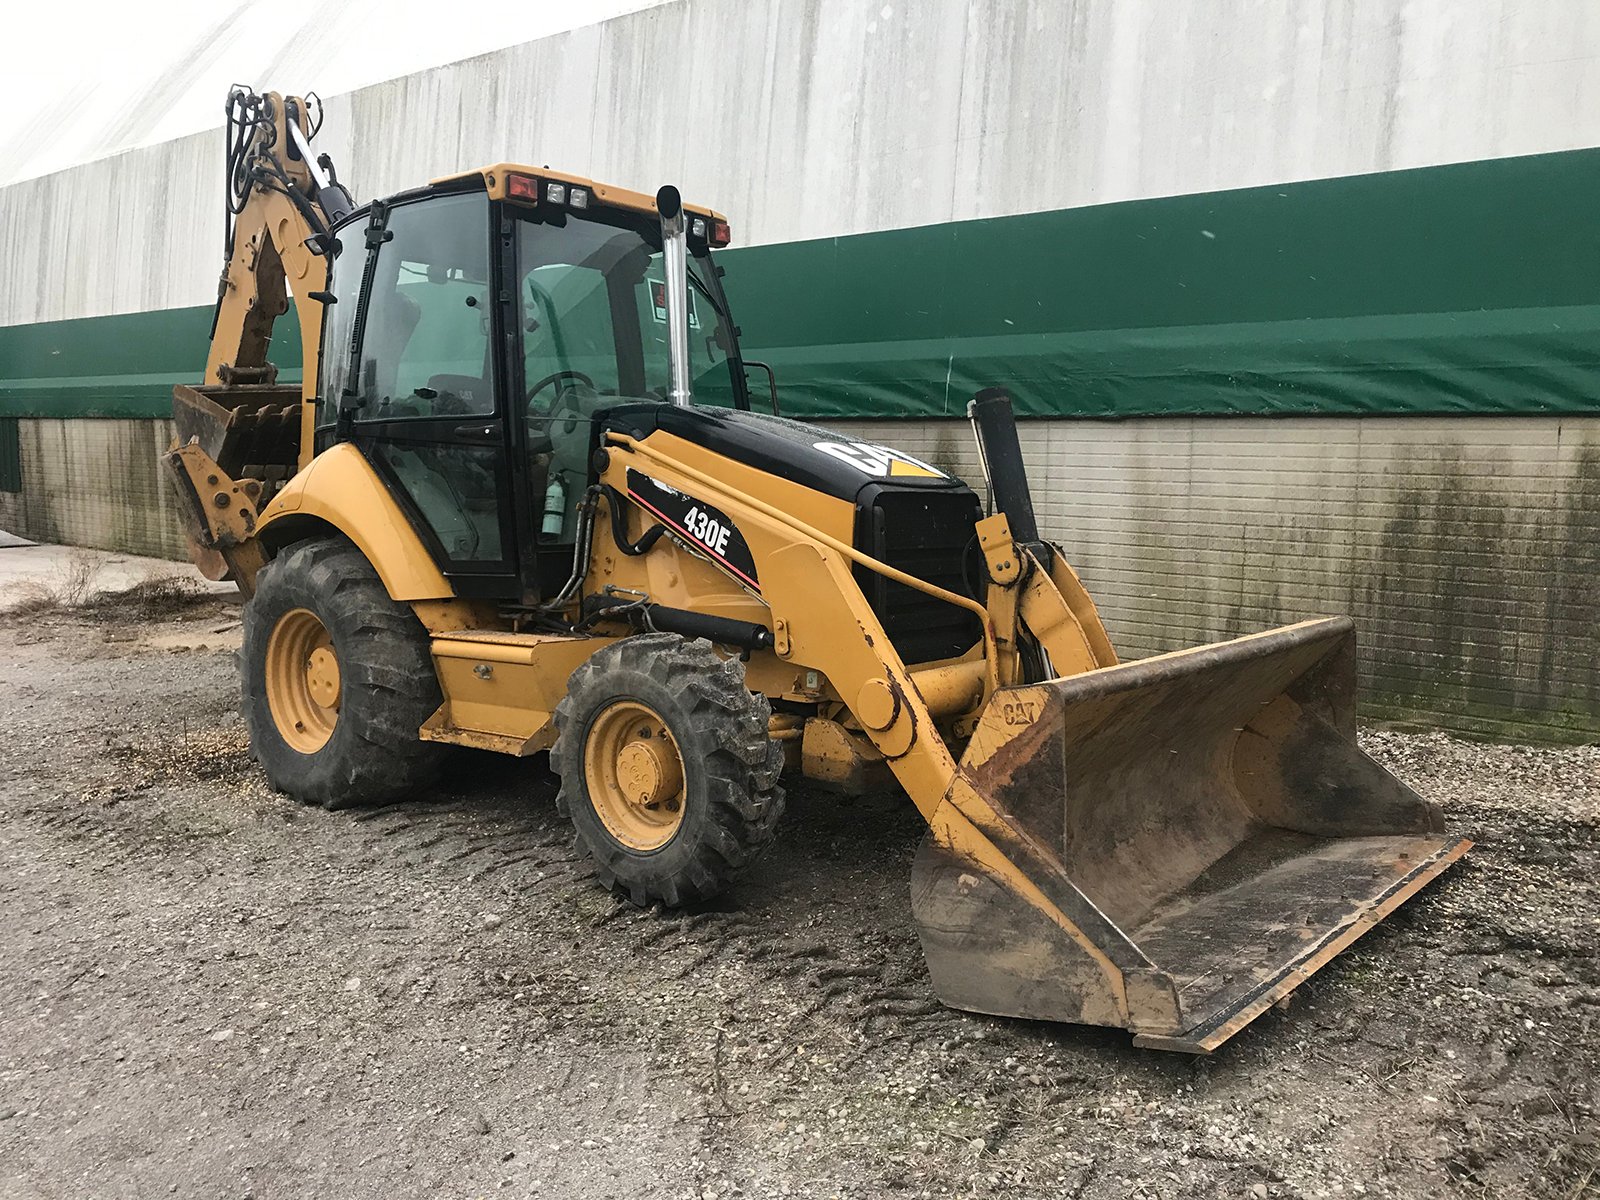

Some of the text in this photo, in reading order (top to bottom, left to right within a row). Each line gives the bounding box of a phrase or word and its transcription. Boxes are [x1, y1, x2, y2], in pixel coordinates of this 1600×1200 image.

[813, 442, 950, 479] CAT
[683, 506, 731, 557] 430E
[1003, 702, 1034, 725] CAT
